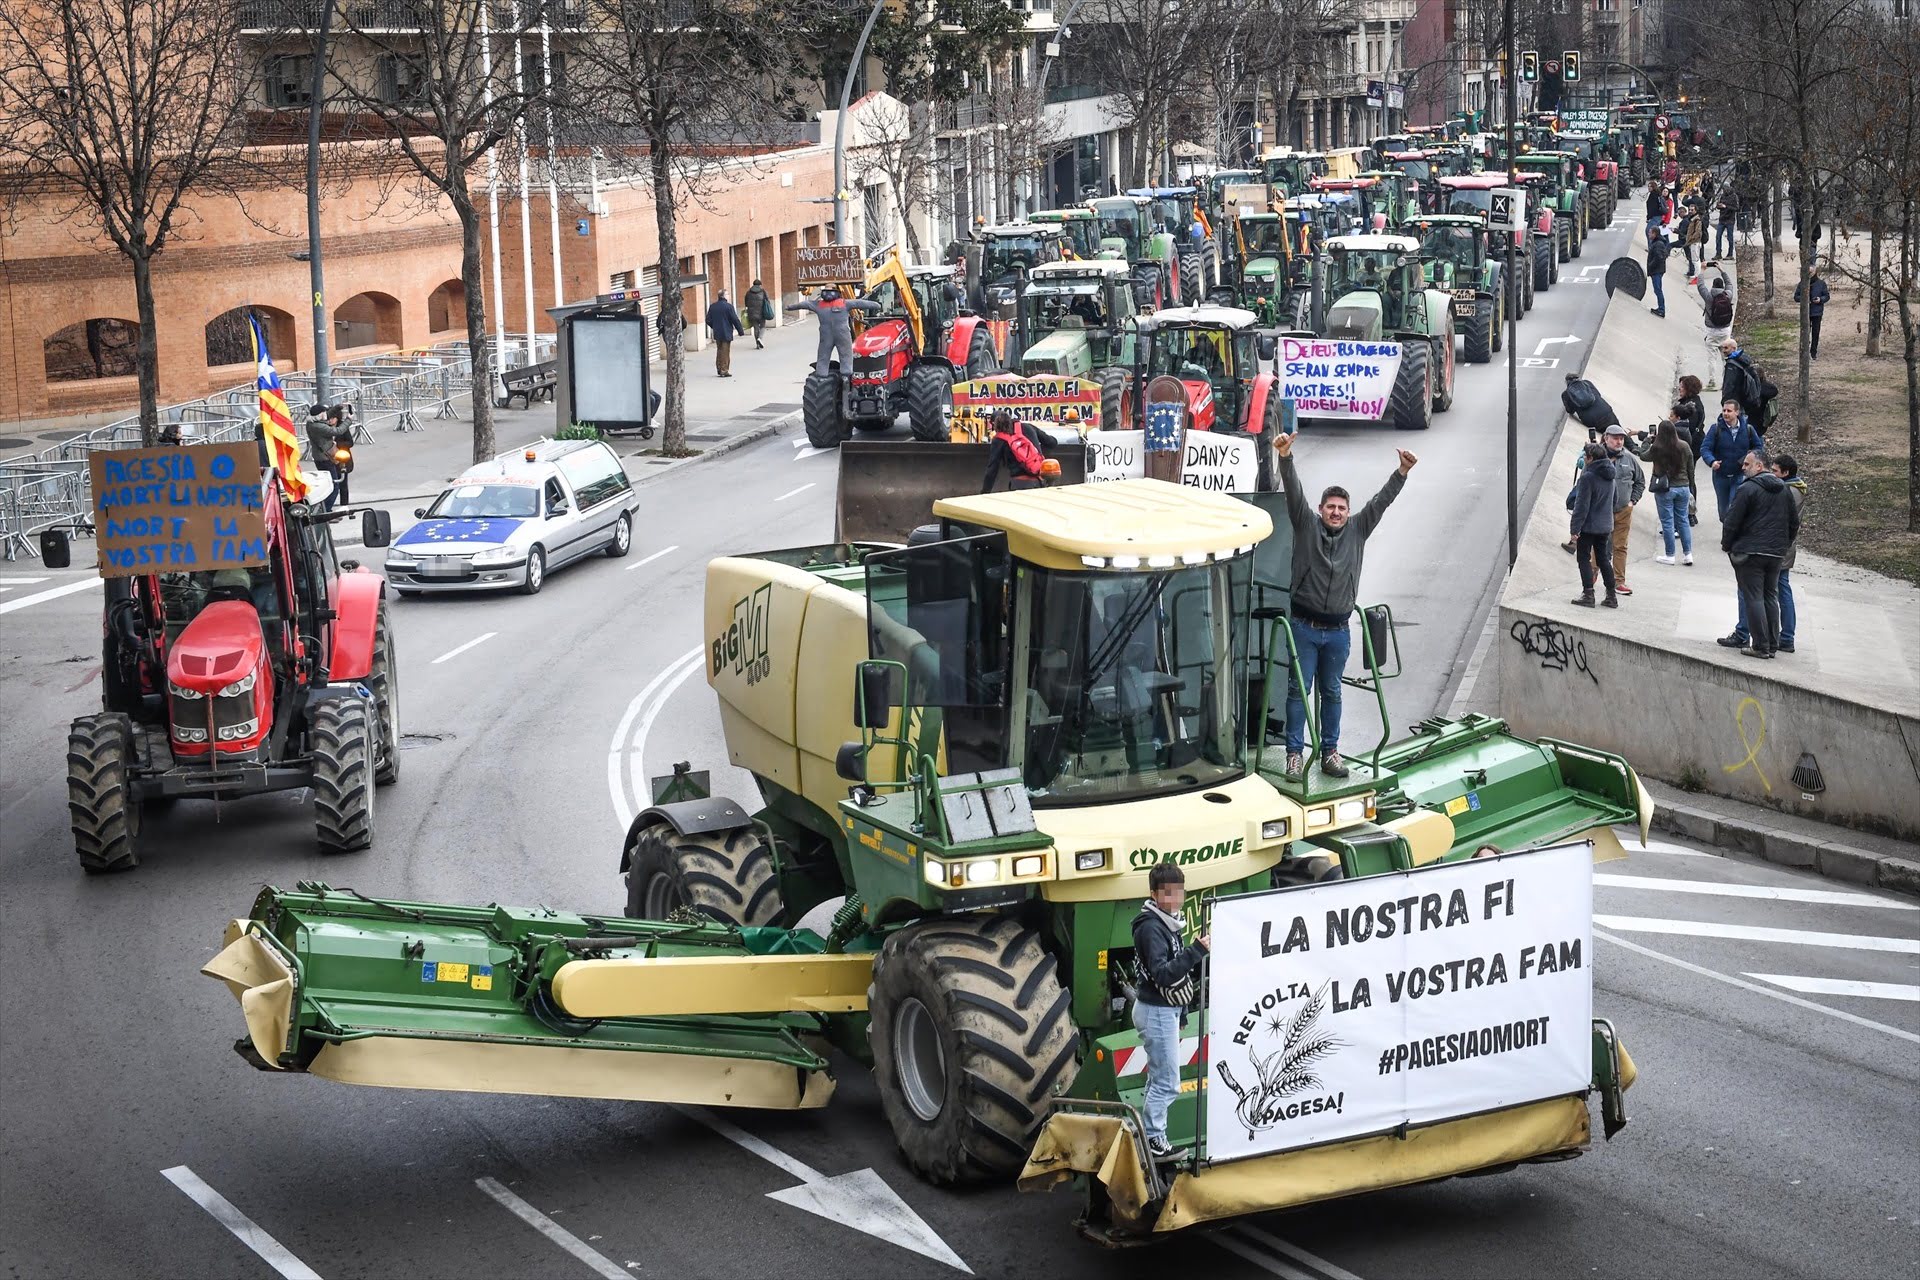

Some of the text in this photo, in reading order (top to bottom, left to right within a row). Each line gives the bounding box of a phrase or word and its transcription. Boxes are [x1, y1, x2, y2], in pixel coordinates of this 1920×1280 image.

[798, 266, 808, 280] LA
[1286, 363, 1380, 378] SERAN SEMPRE
[968, 380, 1079, 399] LA NOSTRA FI
[1285, 382, 1356, 401] NOSTRES!!
[211, 454, 235, 479] O
[1092, 444, 1134, 466] PROU
[1187, 445, 1240, 467] DANYS
[99, 482, 166, 509] MORT
[214, 517, 238, 536] LA
[106, 540, 196, 567] VOSTRA
[1162, 837, 1244, 866] KRONE
[1261, 879, 1515, 958] LA NOSTRA FI
[1331, 938, 1582, 1014] LA VOSTRA FAM
[1233, 982, 1311, 1045] REVOLTA
[1378, 1016, 1550, 1075] #PAGESIAOMORT
[1261, 1091, 1344, 1125] PAGESA!
